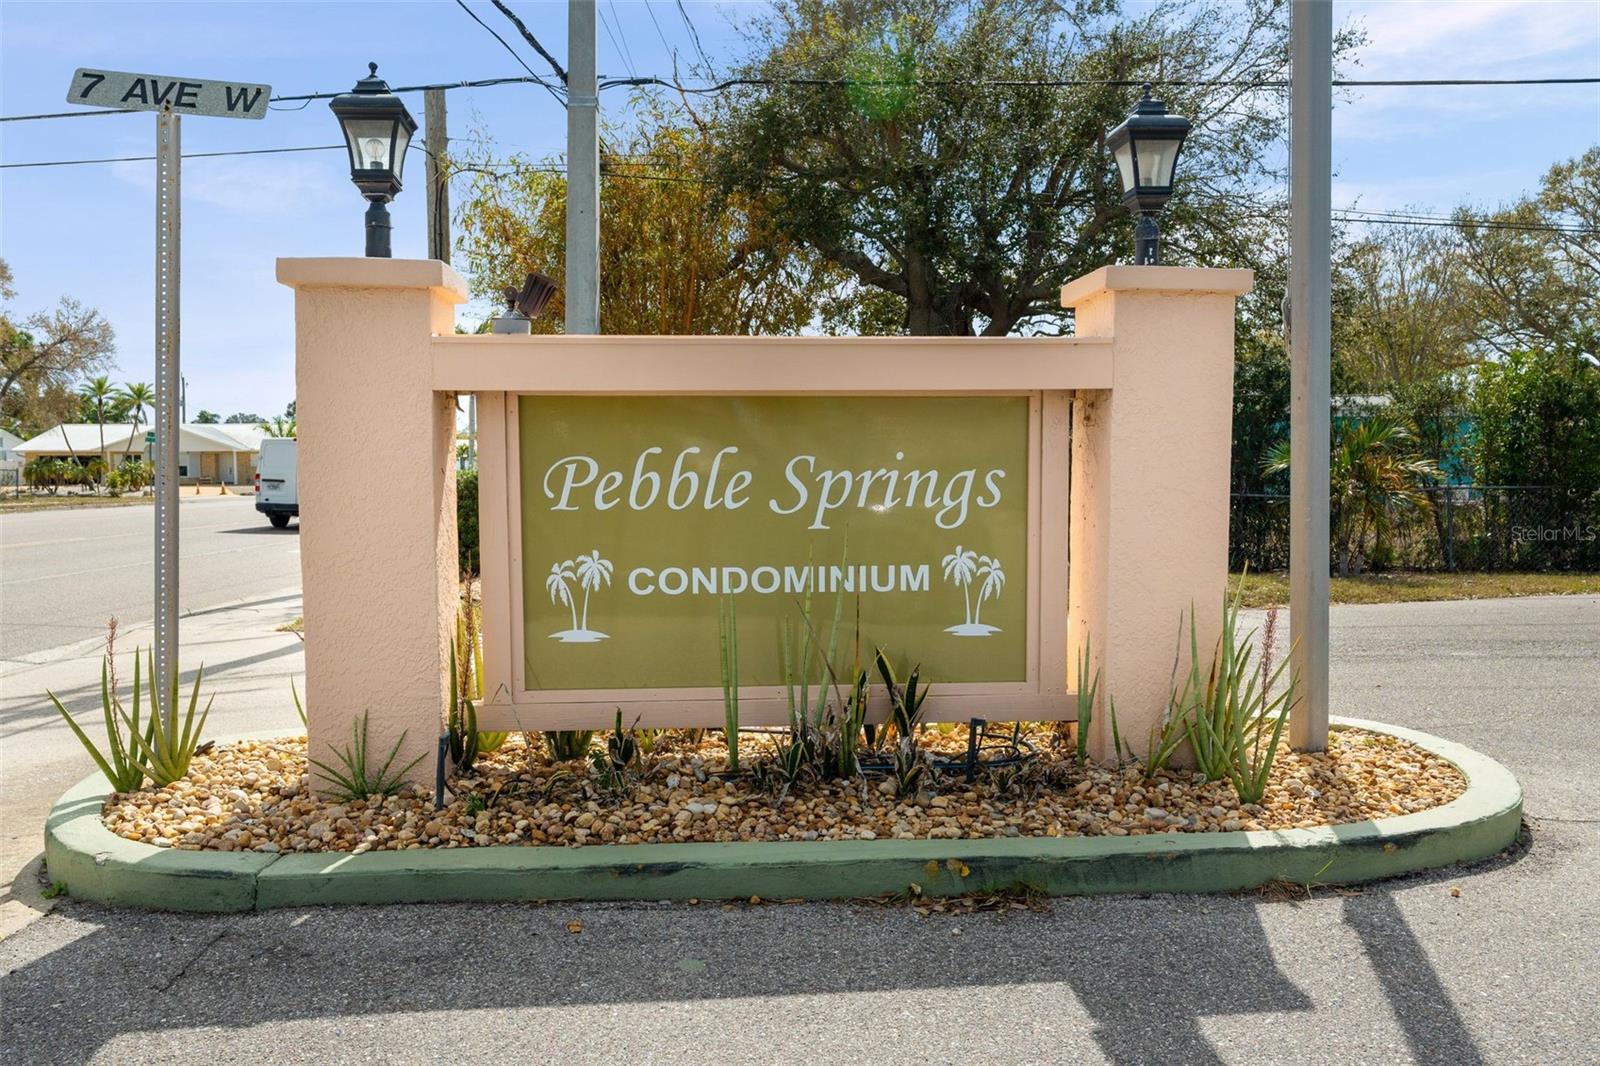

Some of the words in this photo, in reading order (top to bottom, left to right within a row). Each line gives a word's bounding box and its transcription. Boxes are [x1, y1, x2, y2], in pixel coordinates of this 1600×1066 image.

[80, 72, 106, 99] 7
[120, 78, 203, 109] AVE
[225, 86, 262, 113] W
[543, 446, 752, 512] Pebble
[769, 451, 1006, 530] Springs
[628, 564, 930, 596] CONDOMINIUM
